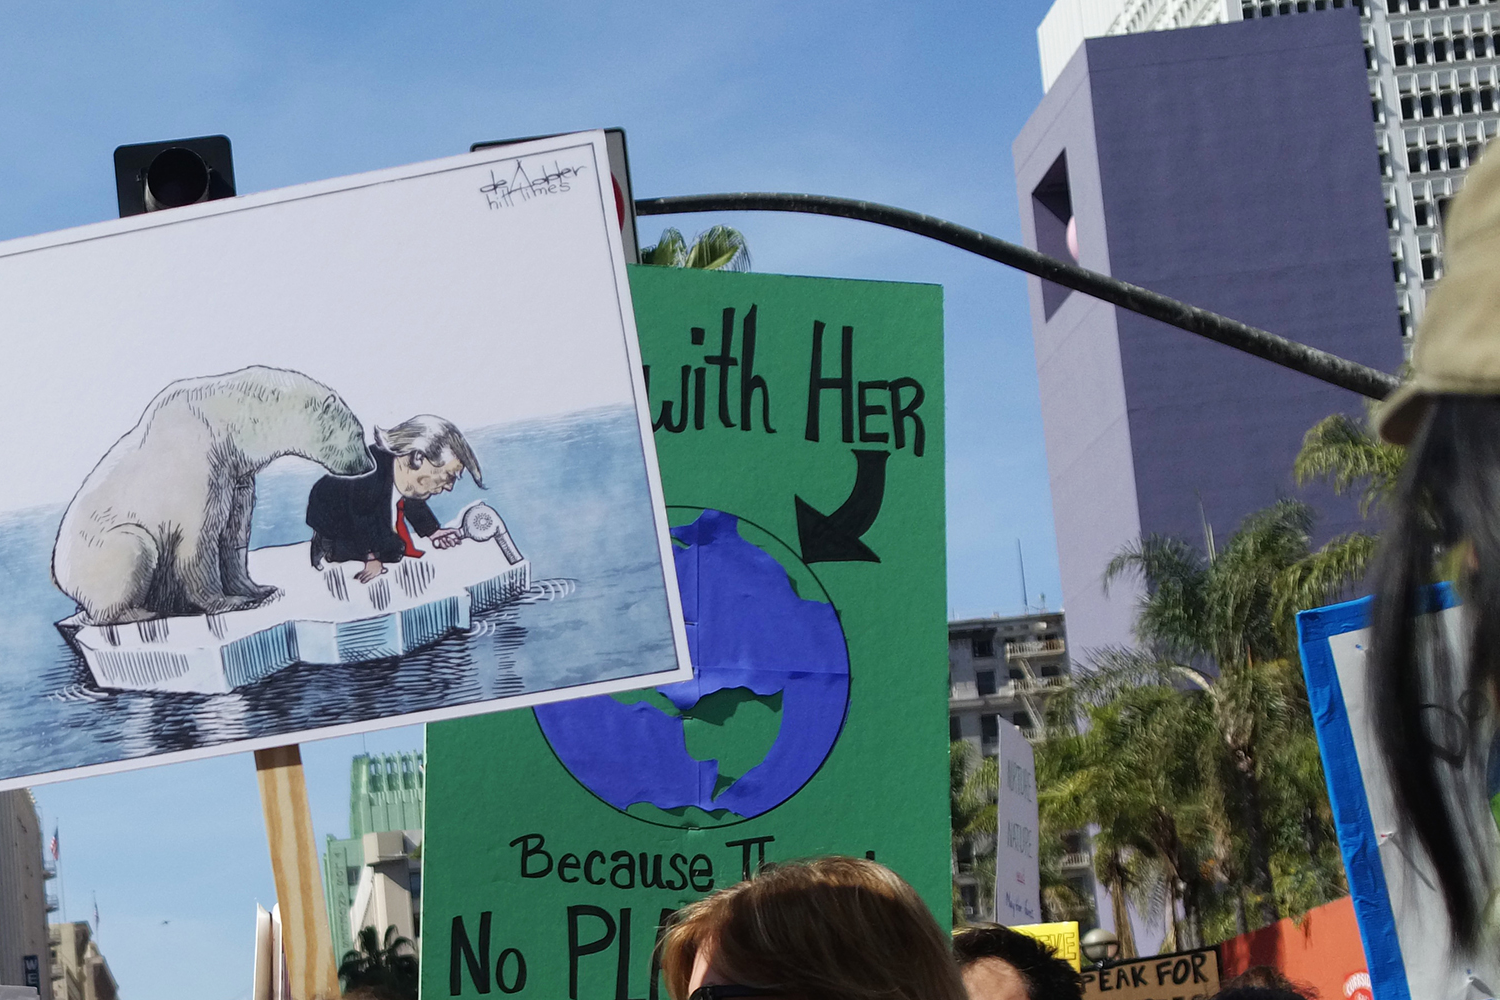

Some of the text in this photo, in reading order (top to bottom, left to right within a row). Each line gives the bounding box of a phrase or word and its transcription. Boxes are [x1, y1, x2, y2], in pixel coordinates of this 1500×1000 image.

[642, 303, 926, 458] with HER
[509, 832, 717, 893] Because
[450, 910, 527, 997] No
[1079, 953, 1209, 996] PEAK FOR
